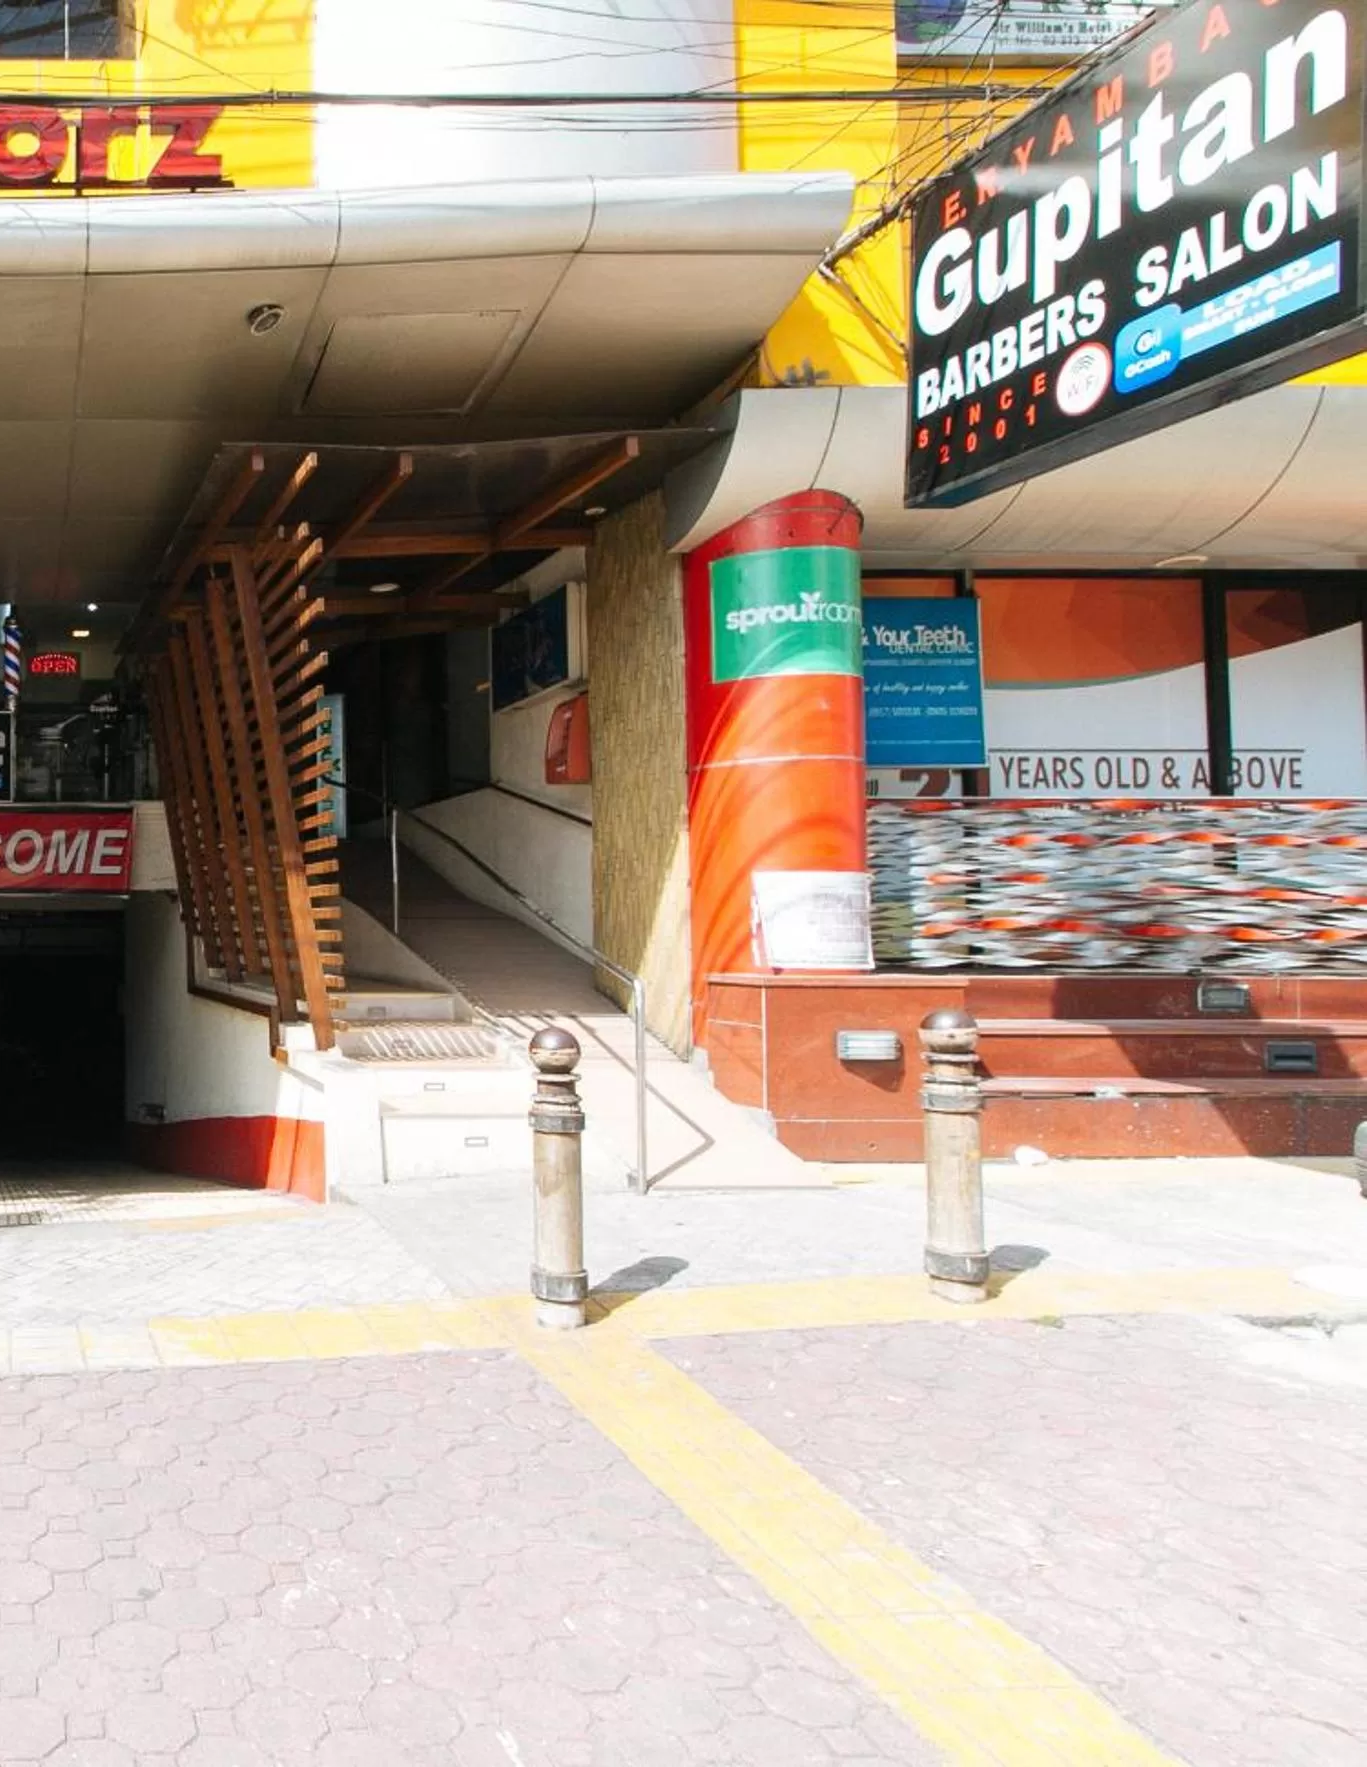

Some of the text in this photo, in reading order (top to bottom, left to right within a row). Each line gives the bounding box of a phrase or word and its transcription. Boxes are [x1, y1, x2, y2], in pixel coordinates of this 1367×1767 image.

[915, 10, 1348, 337] Gupitan
[916, 151, 1339, 419] BARBERS SALON
[940, 404, 1036, 464] 2001
[873, 625, 911, 647] Your
[913, 625, 966, 647] Teeth
[31, 658, 77, 673] OPEN
[1000, 756, 1084, 789] YEARS
[1095, 756, 1150, 789] OLD
[1161, 756, 1181, 789] &
